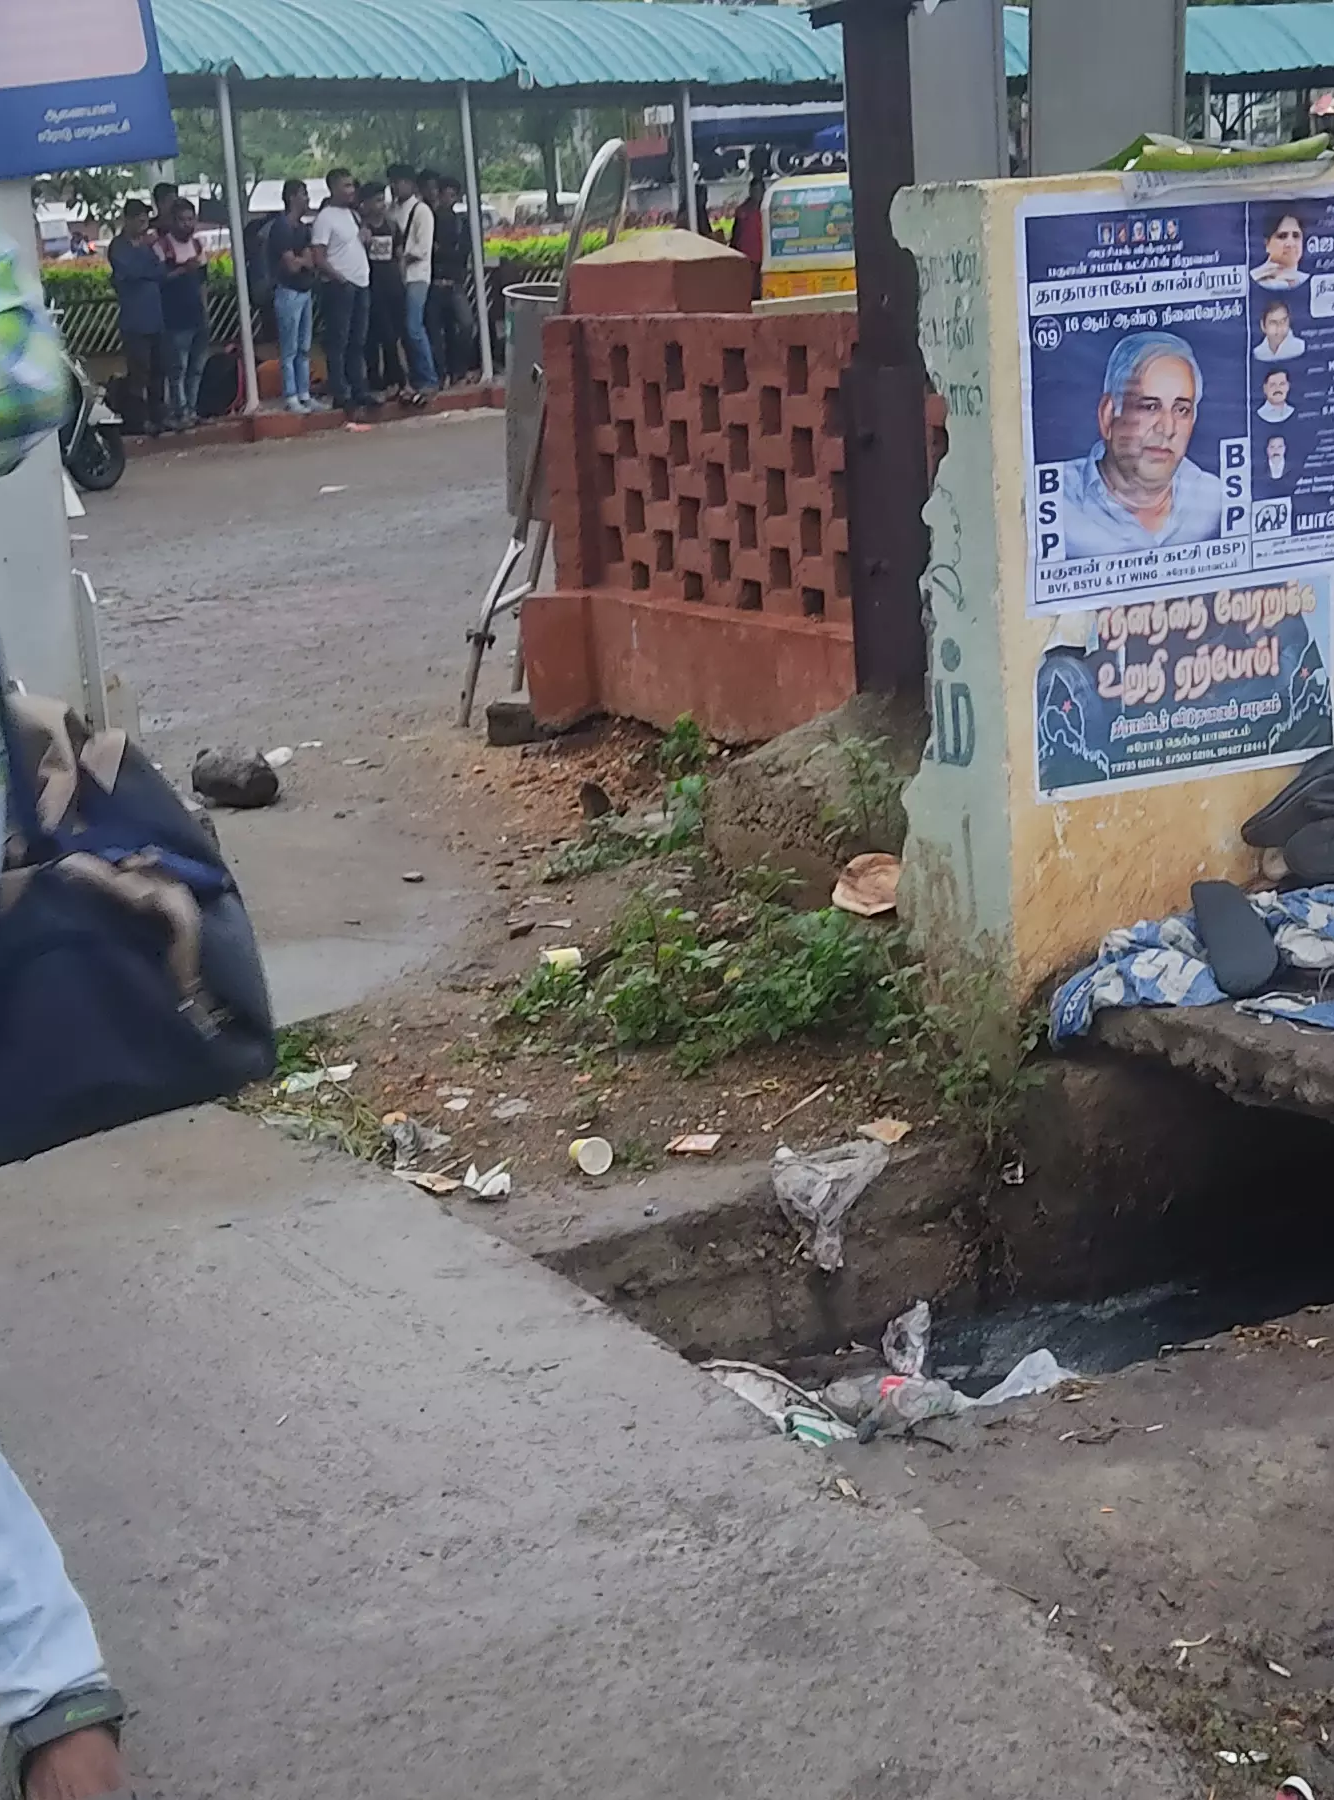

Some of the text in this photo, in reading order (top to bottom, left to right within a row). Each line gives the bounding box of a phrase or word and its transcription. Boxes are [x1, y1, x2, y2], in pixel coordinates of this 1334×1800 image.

[1035, 267, 1243, 308] தாதாசாகேப் கான்சிராம்
[1065, 299, 1244, 334] 16 ஆம் ஆண்டு நினைவேந்தல்
[1037, 329, 1058, 347] 09
[1225, 443, 1246, 532] BSP
[1038, 468, 1060, 560] BSP
[1040, 558, 1101, 581] பகுஜன்
[1105, 550, 1159, 572] சமாஜ்
[1162, 545, 1203, 564] கட்சி
[1206, 541, 1247, 560] (BSP)
[1048, 582, 1072, 595] BVF,
[1073, 577, 1102, 590] BSTU
[1105, 575, 1113, 586] &
[1116, 574, 1128, 585] IT
[1130, 570, 1159, 584] WING
[1098, 636, 1280, 707] உறுதி ஏற்போம்!
[1202, 723, 1252, 743] மாவட்டம்
